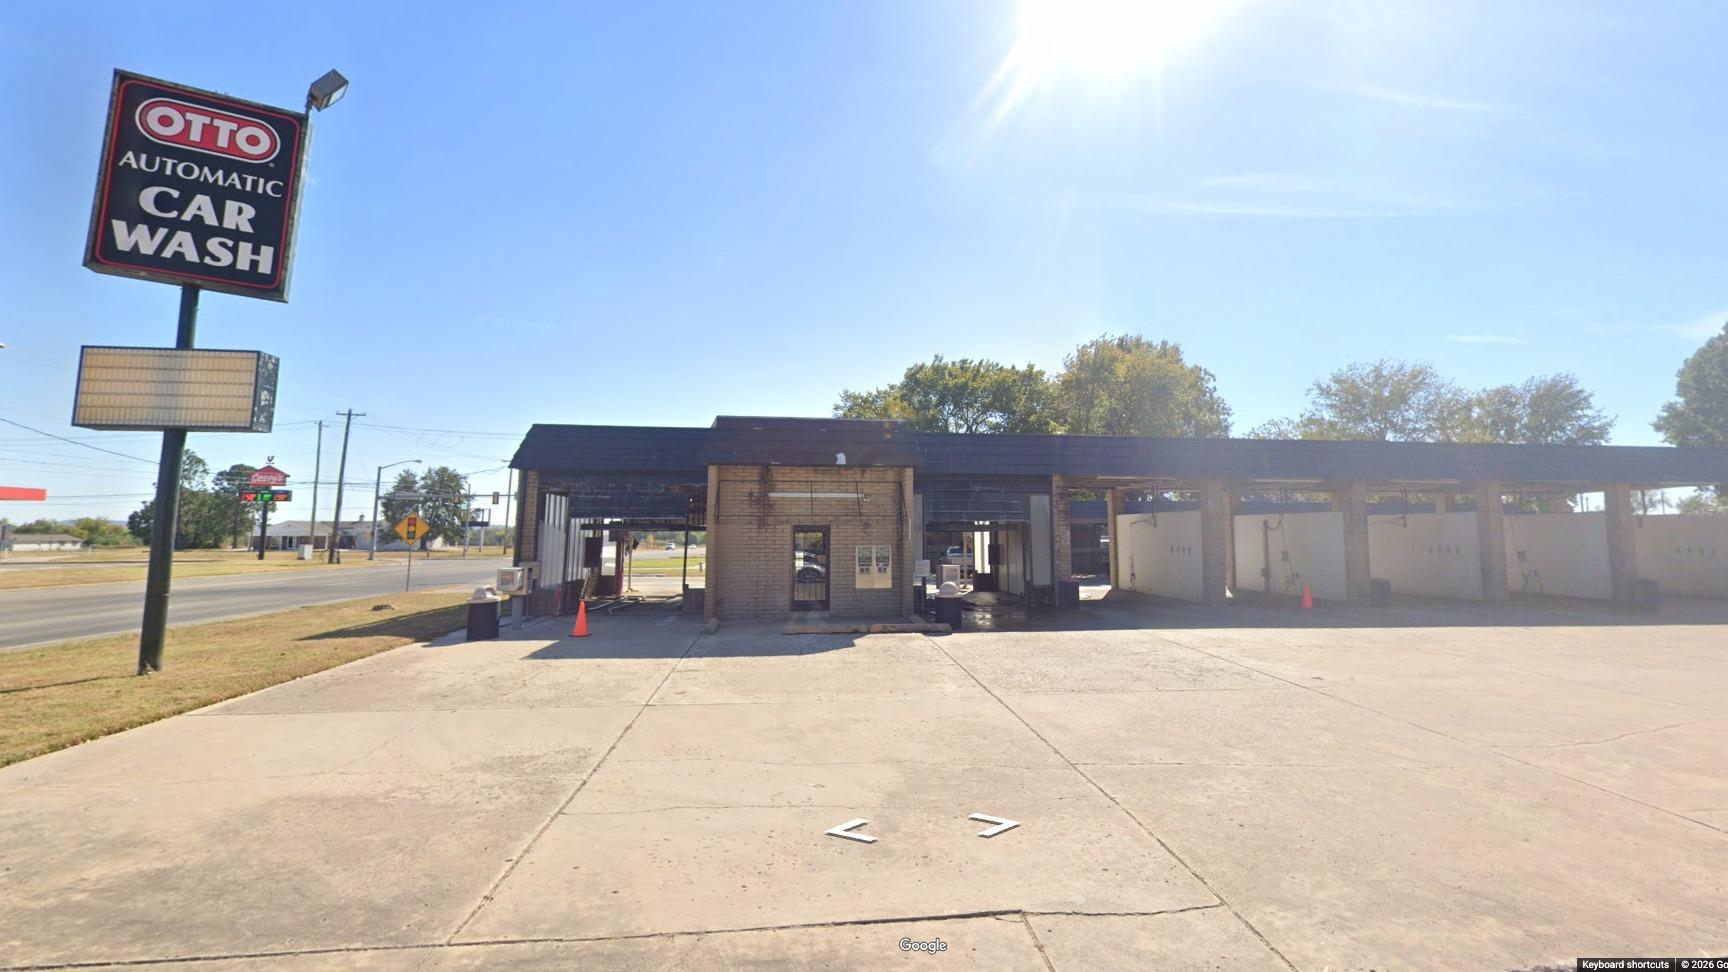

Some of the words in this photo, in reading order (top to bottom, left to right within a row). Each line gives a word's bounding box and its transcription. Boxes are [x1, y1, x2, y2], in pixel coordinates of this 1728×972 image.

[146, 106, 271, 155] OTTO
[118, 150, 284, 198] AUTOMATIC
[138, 186, 256, 233] CAR
[111, 219, 274, 275] WASH
